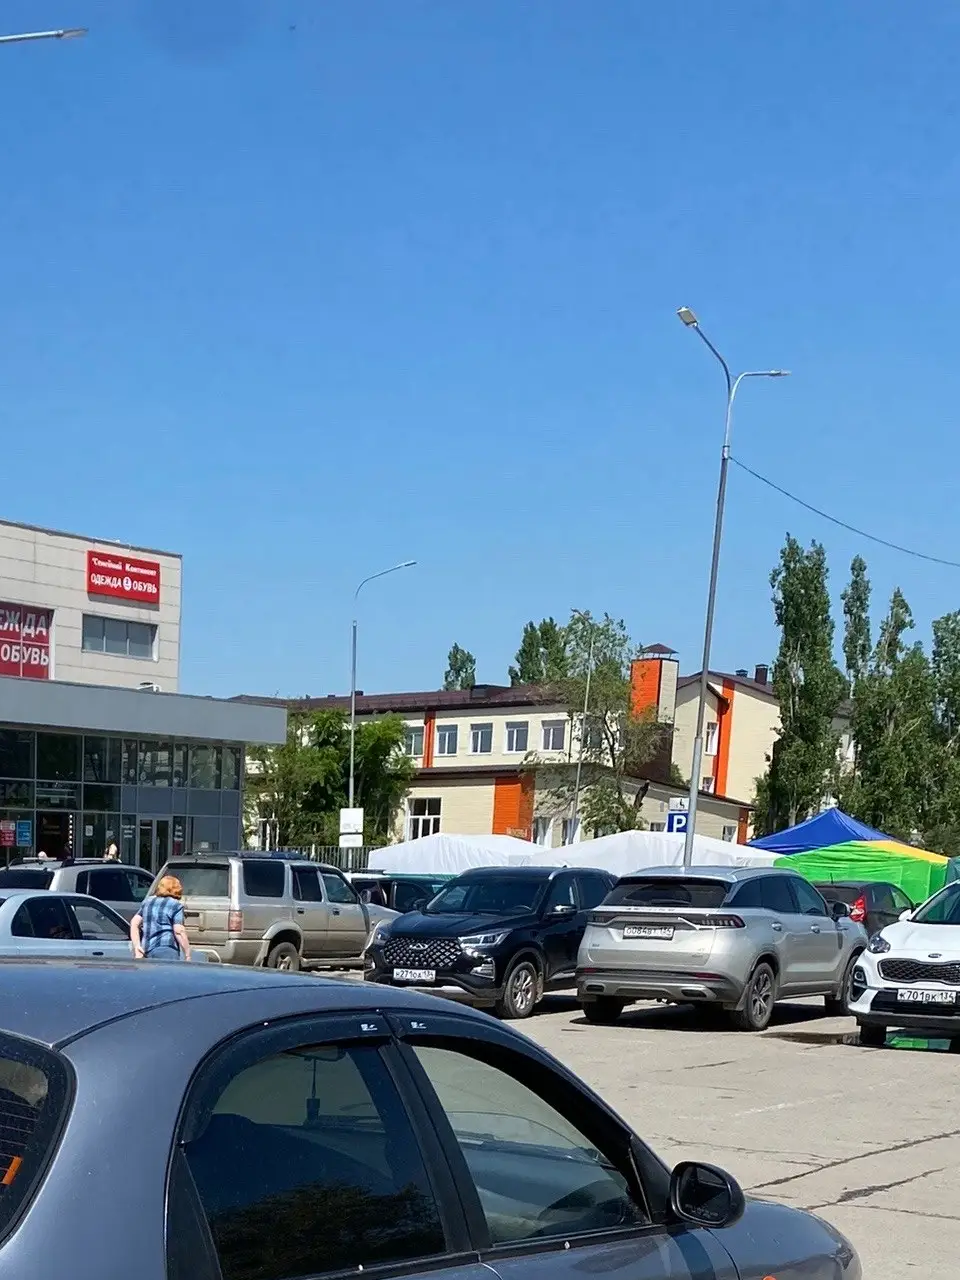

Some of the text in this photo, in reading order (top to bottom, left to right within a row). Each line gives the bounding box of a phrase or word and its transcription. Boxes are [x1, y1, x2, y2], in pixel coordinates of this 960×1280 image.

[90, 573, 122, 588] ОДЕЖДА
[132, 581, 157, 593] ОБУВЬ
[0, 644, 49, 666] ОБУВЬ
[672, 814, 687, 832] P
